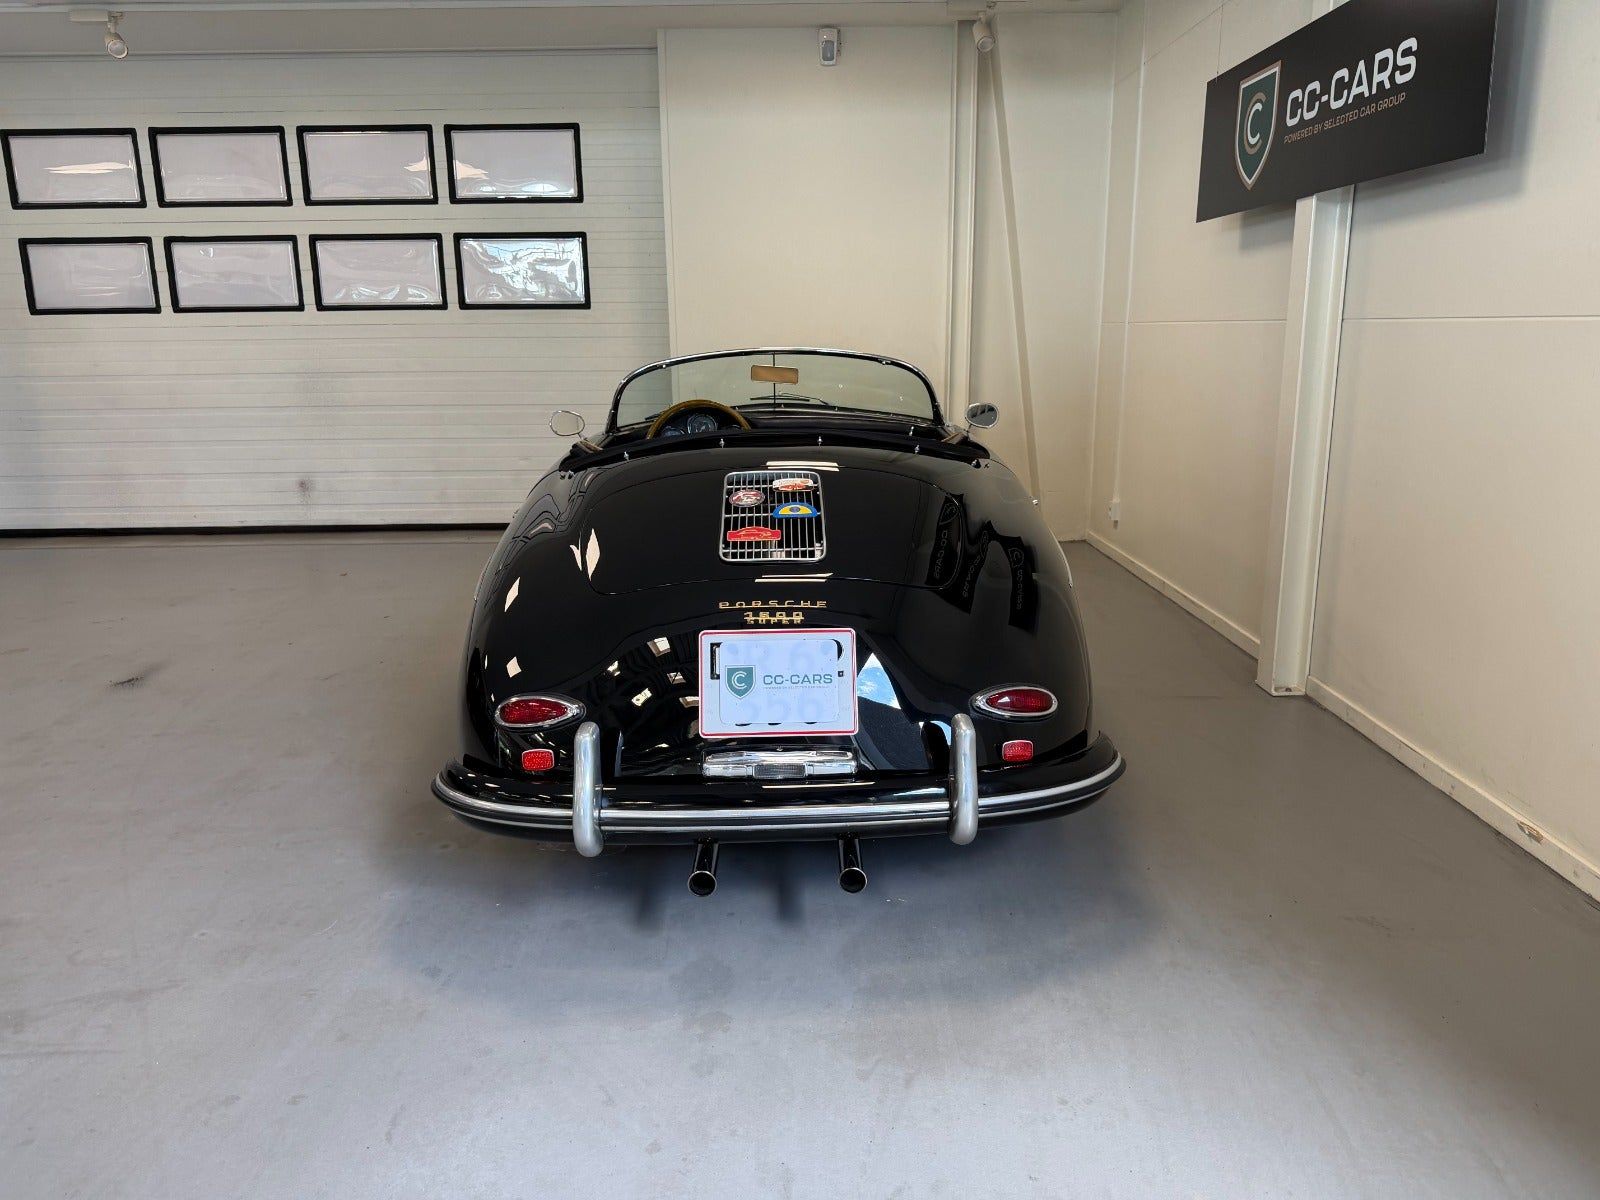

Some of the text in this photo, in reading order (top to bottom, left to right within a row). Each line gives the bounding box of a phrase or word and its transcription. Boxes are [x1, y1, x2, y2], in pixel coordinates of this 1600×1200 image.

[1286, 37, 1418, 127] CC-CARS
[1283, 92, 1406, 144] POWERED BY SELECTED CAR GROUP
[719, 600, 827, 609] PORSCHE
[743, 611, 804, 620] 1600
[762, 673, 833, 685] CC-CARS
